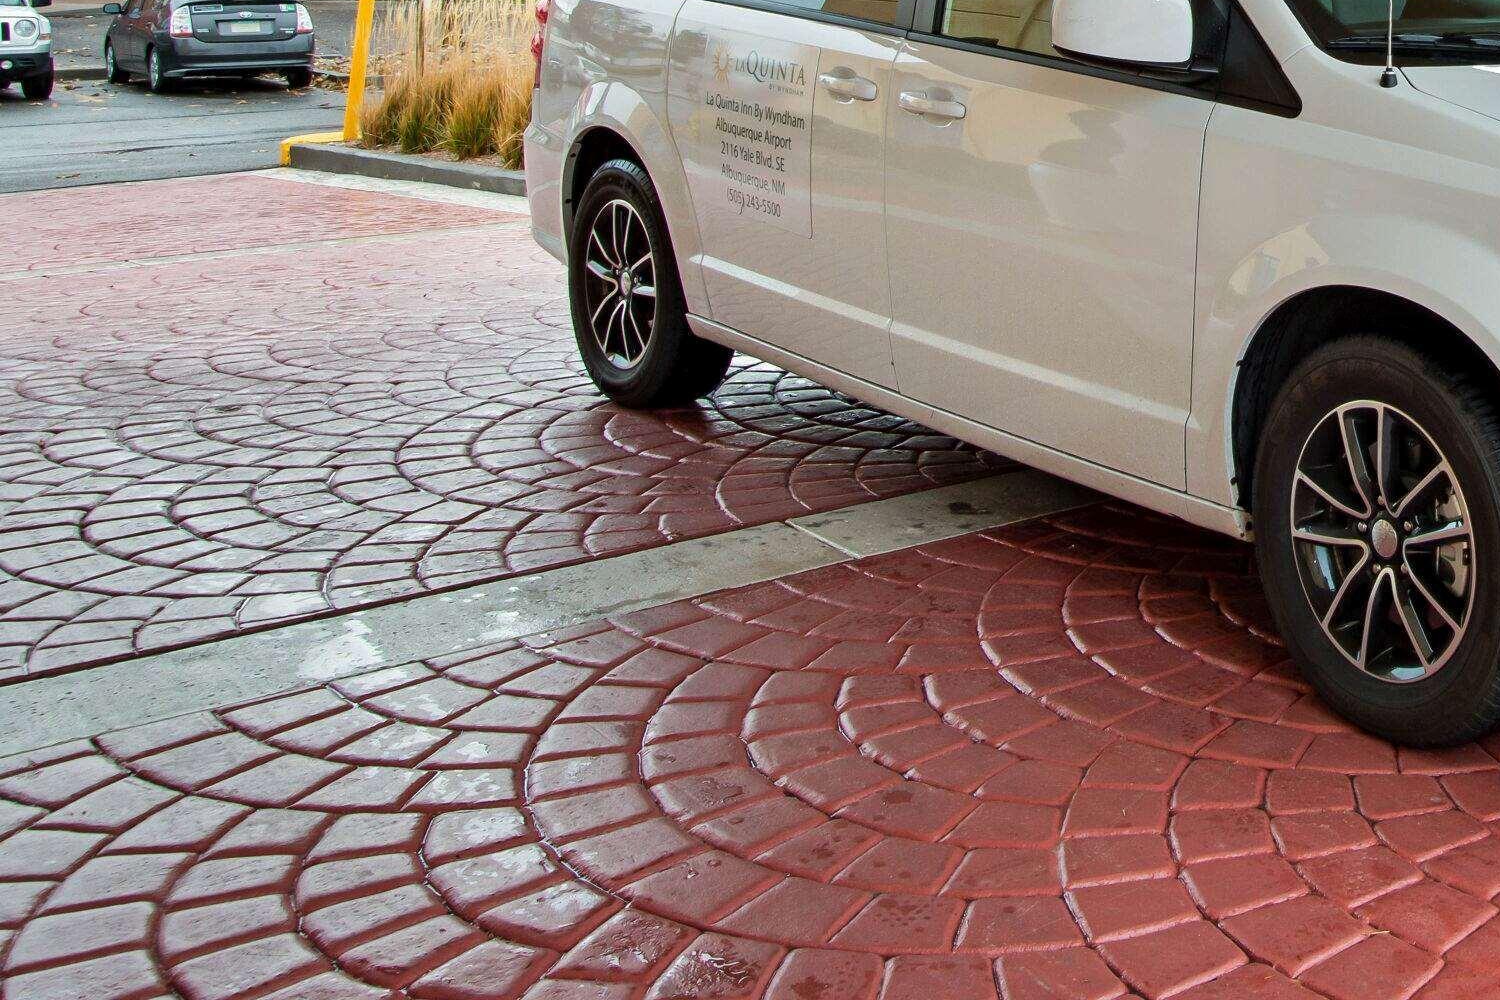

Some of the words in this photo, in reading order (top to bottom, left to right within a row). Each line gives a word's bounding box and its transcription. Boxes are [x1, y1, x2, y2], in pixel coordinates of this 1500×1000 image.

[705, 91, 715, 106] La
[715, 94, 740, 113] Quinta
[740, 100, 753, 116] Inn
[754, 103, 764, 122] By
[765, 105, 805, 130] Wyndham
[715, 117, 763, 143] Albuquerque
[764, 130, 792, 151] Airport
[720, 140, 739, 159] 2116
[739, 146, 754, 163] Yale
[755, 150, 774, 169] Blvd.
[775, 156, 785, 172] SE
[727, 186, 745, 215] (505)
[746, 194, 781, 218] 243-5500
[771, 178, 786, 197] NM
